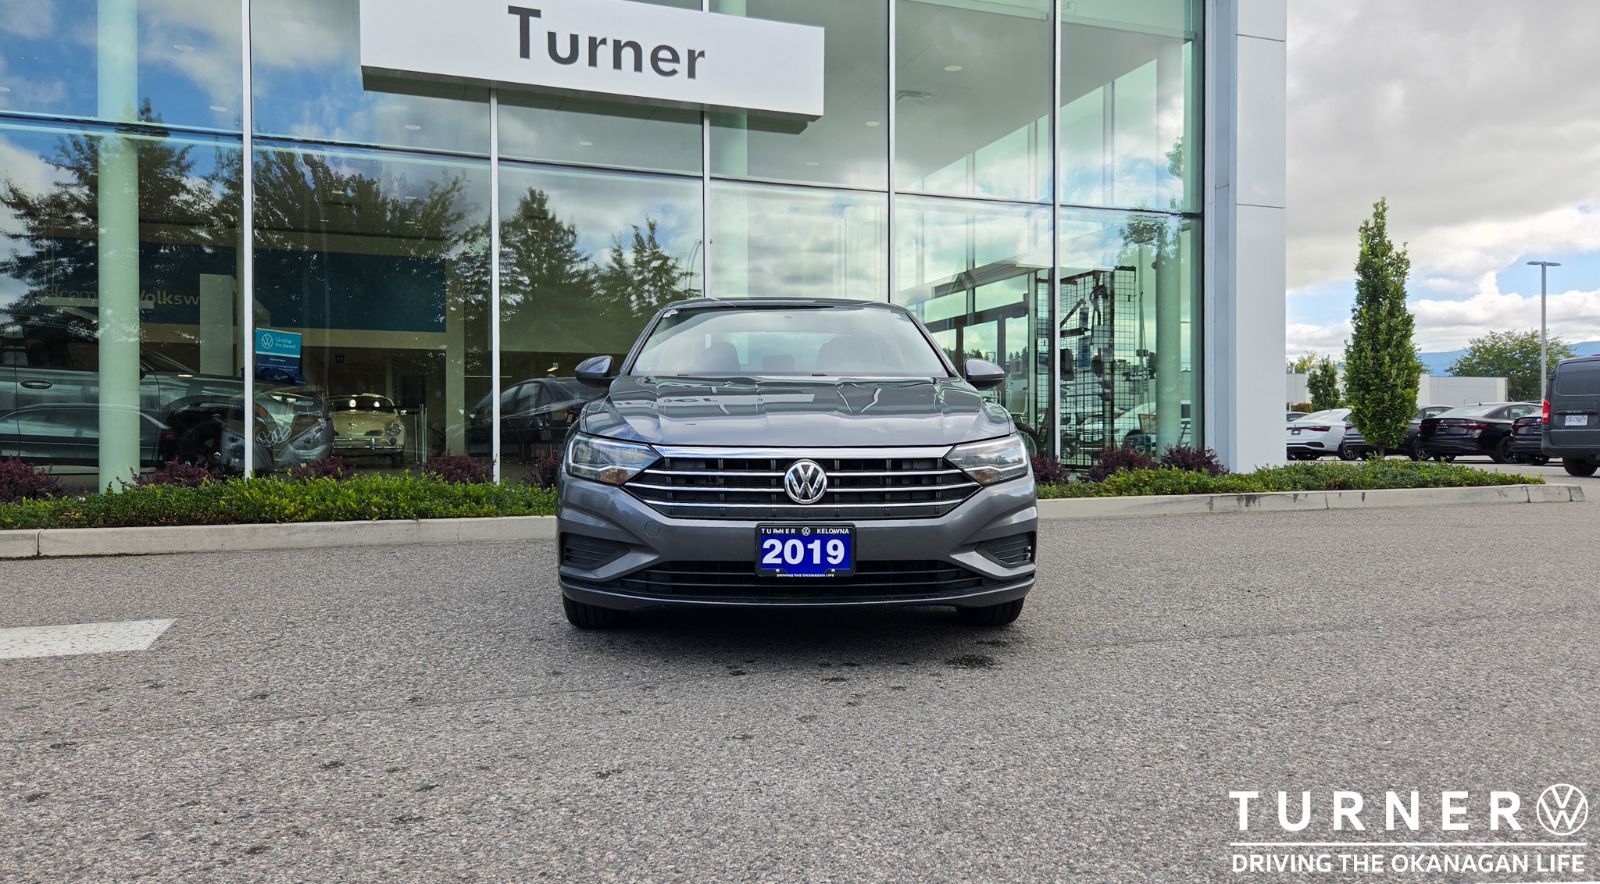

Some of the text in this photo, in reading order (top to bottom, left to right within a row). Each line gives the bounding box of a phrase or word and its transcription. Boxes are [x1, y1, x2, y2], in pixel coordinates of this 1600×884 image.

[507, 5, 706, 80] Turner
[140, 289, 200, 305] olksw
[785, 459, 827, 504] VW
[762, 538, 845, 565] 2019
